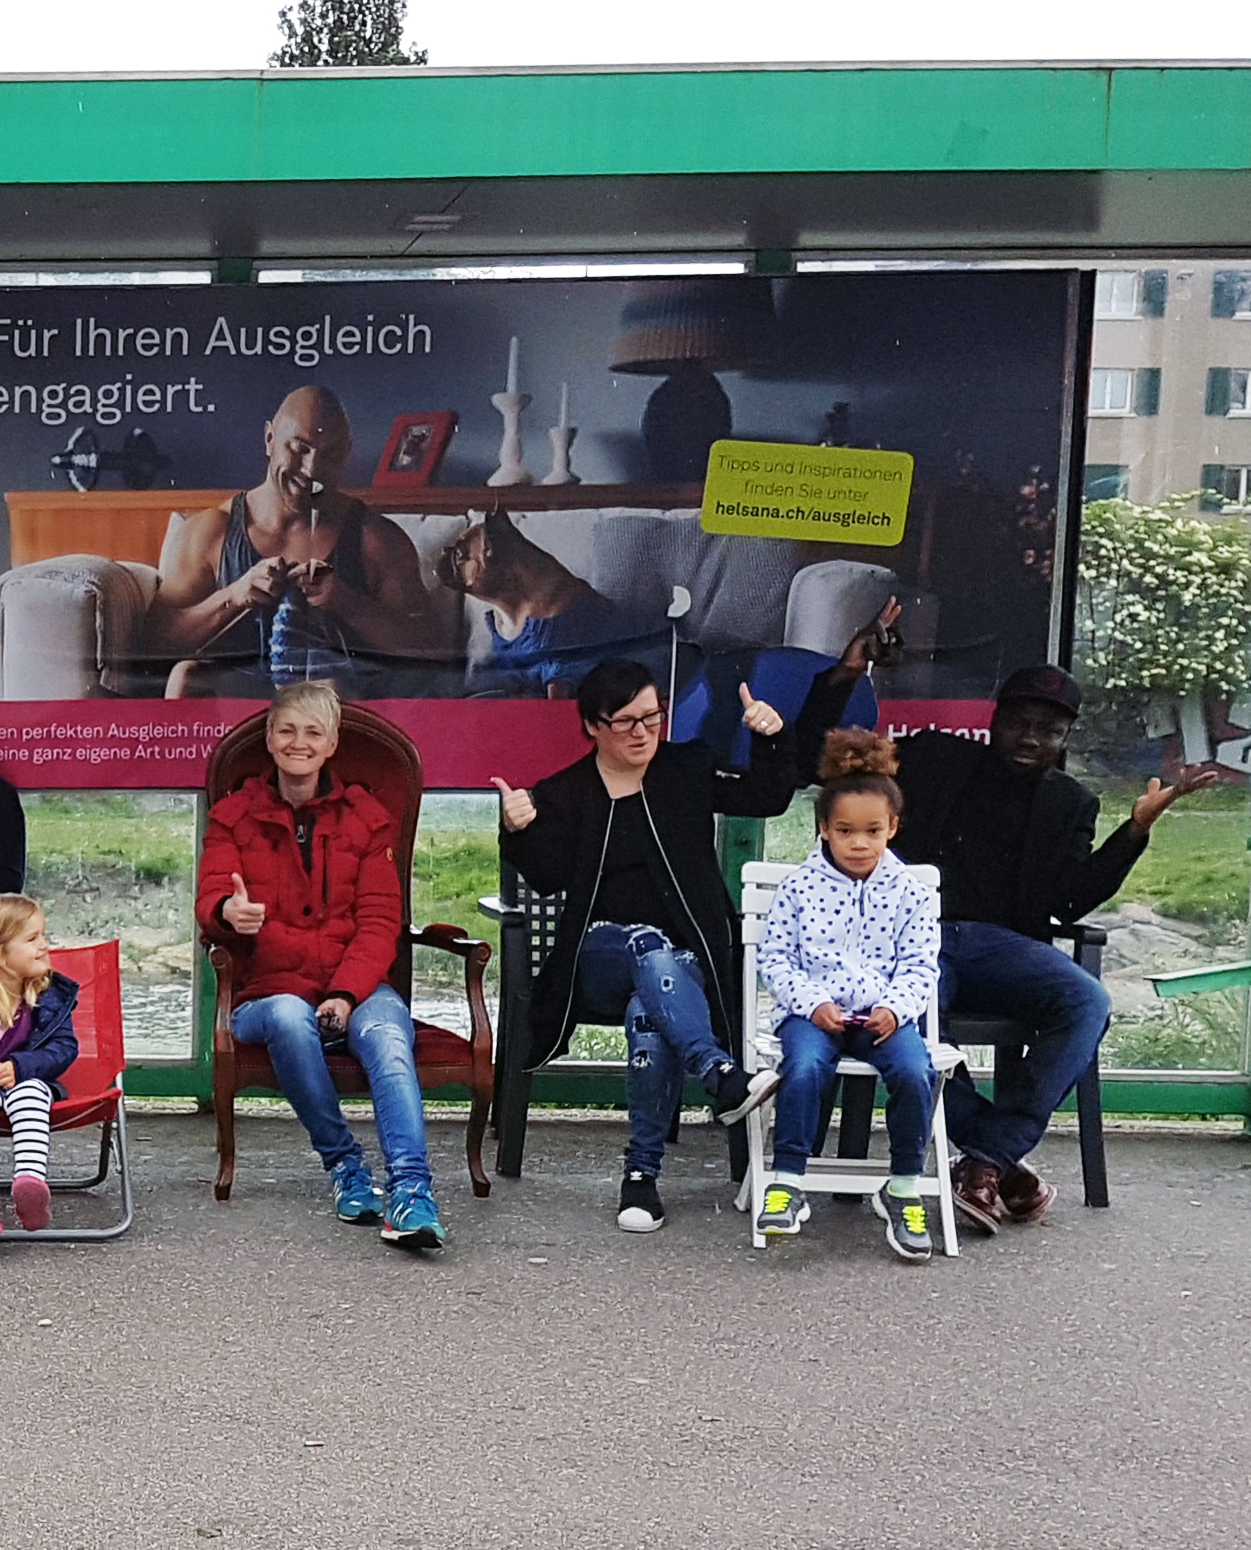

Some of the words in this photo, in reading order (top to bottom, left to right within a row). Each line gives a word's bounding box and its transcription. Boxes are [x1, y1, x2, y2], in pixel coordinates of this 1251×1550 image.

[74, 317, 189, 357] Ihren
[204, 314, 433, 367] Ausgleich
[718, 454, 761, 474] Tipps
[764, 461, 796, 475] und
[798, 462, 904, 482] Inspirationen
[744, 479, 795, 497] finden
[798, 483, 823, 499] Sie
[826, 488, 870, 503] unter
[715, 500, 892, 528] helsana.ch/ausgleich
[22, 722, 104, 743] perfekten
[107, 721, 189, 743] Ausgleich
[32, 748, 73, 765] ganz
[75, 744, 131, 765] eigene
[133, 743, 161, 760] Art
[164, 743, 197, 760] und
